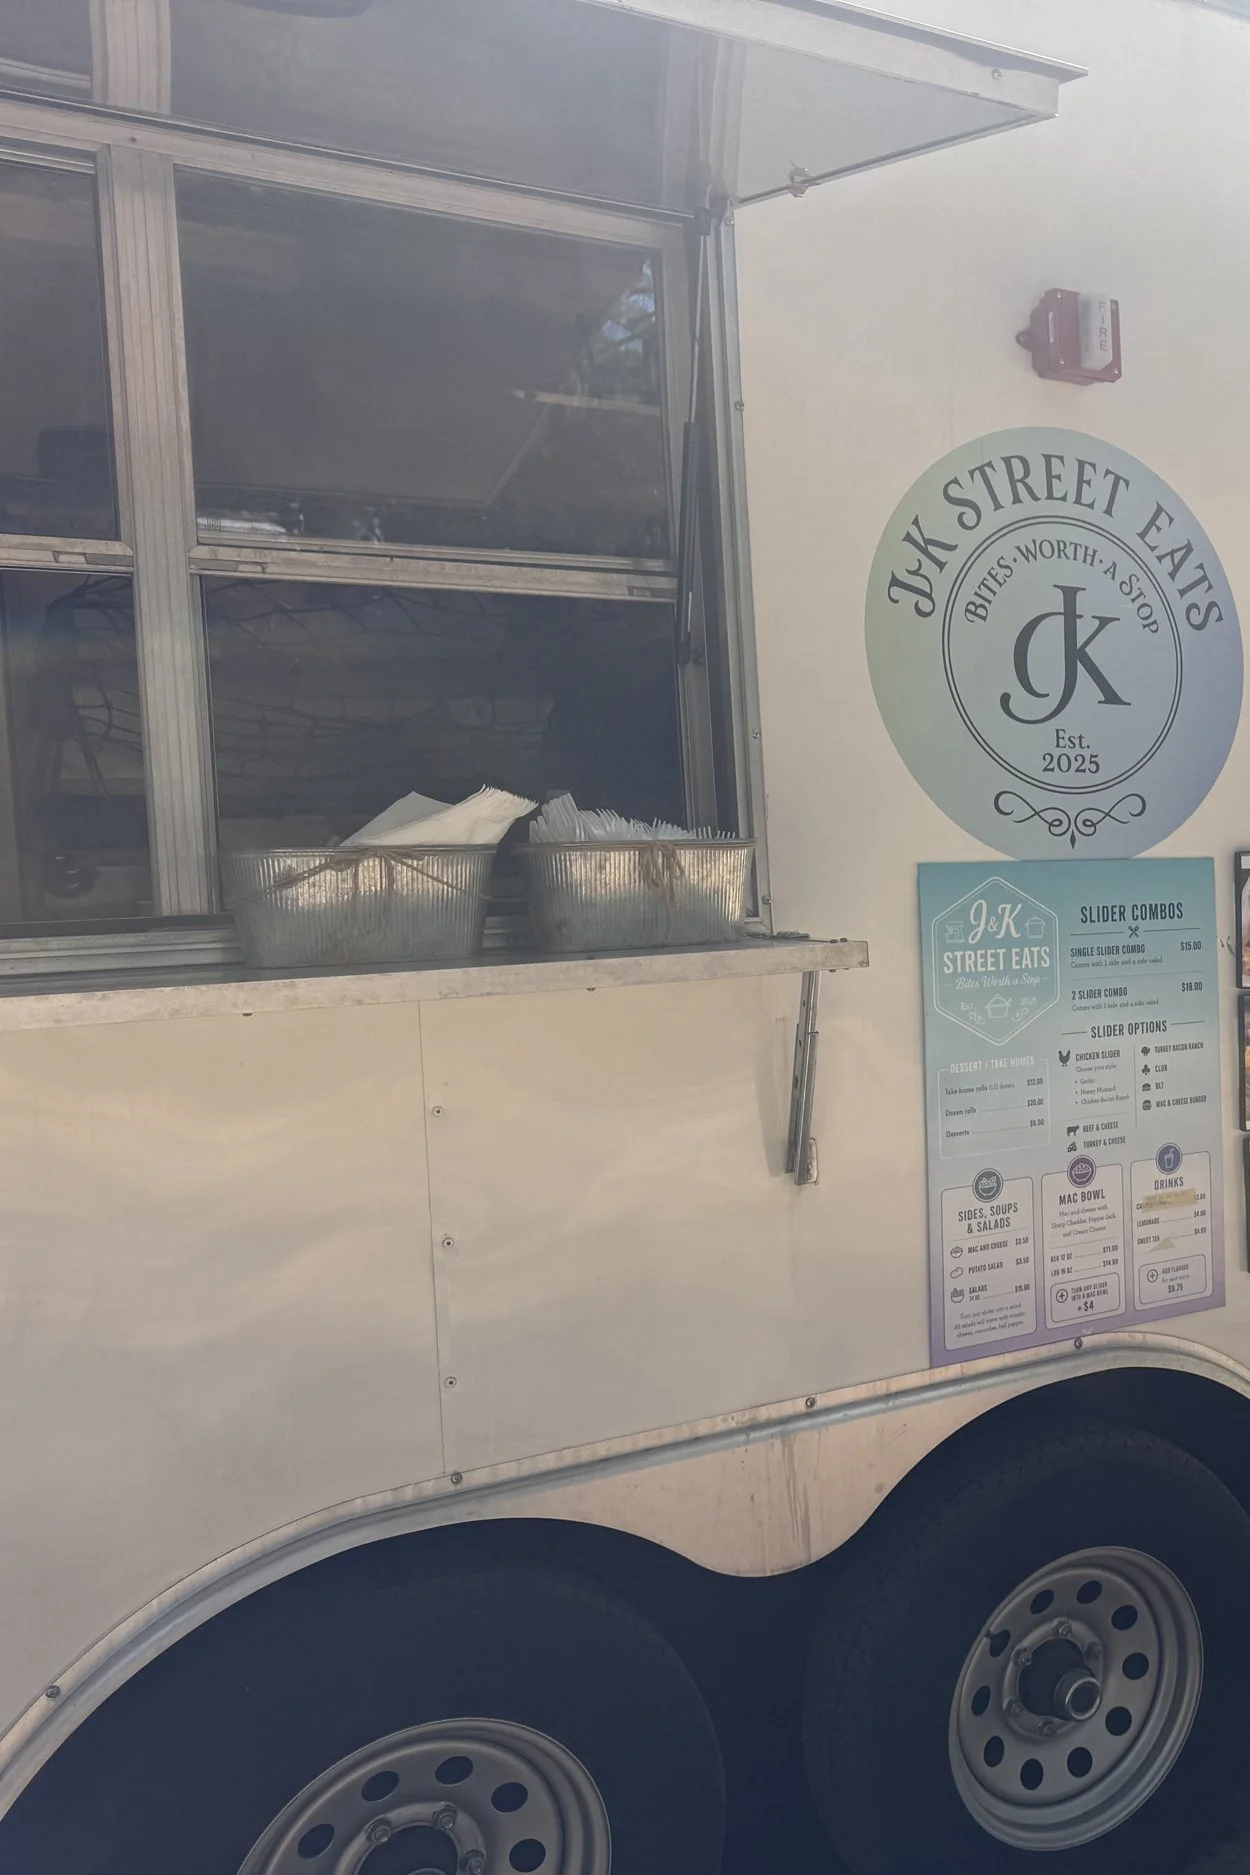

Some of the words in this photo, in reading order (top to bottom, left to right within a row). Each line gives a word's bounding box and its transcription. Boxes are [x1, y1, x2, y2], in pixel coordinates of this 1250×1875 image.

[1098, 300, 1108, 352] FIRE
[942, 452, 1131, 531] STREET
[1136, 500, 1223, 631] EATS
[1054, 728, 1090, 750] Est.
[1042, 753, 1100, 774] 2025
[968, 899, 1022, 944] J&K
[1080, 904, 1126, 924] SLIDER
[1131, 902, 1184, 921] COMBOS
[1070, 948, 1095, 958] SINGLE
[1096, 946, 1120, 956] SLIDER
[1122, 944, 1145, 954] COMBO
[1180, 941, 1202, 951] $15.00
[943, 948, 1005, 974] STREET
[1012, 946, 1050, 969] EATS
[1108, 958, 1119, 966] side
[1149, 954, 1162, 964] salad
[956, 976, 979, 990] Bites
[982, 976, 1010, 987] Worth
[1020, 973, 1040, 986] Stop
[1072, 991, 1076, 1000] 2
[1078, 989, 1102, 999] SLIDER
[1104, 987, 1128, 998] COMBO
[1182, 981, 1202, 992] $18.00
[1091, 1026, 1124, 1039] SLIDER
[1128, 1020, 1168, 1036] OPTIONS
[1075, 1052, 1100, 1062] CHICKEN
[1101, 1050, 1121, 1059] SLIDER
[1154, 1045, 1172, 1053] TURKEY
[950, 1061, 982, 1074] DESSERT
[991, 1058, 1008, 1070] TAKE
[1011, 1056, 1035, 1068] HOMES
[1155, 1064, 1168, 1072] CLUB
[1027, 1077, 1043, 1086] $12.00
[1155, 1081, 1164, 1089] BLT
[945, 1109, 963, 1117] Dozen
[964, 1106, 976, 1114] rolls
[1027, 1098, 1044, 1107] $20.00
[1156, 1100, 1166, 1108] MAC
[1172, 1097, 1188, 1106] CHEESE
[1189, 1095, 1207, 1104] BURGER
[945, 1130, 969, 1138] Desserts
[1082, 1124, 1094, 1132] BEEF
[1095, 1123, 1100, 1131] &
[1101, 1120, 1119, 1130] CHEESE
[1084, 1139, 1102, 1148] TURKEY
[1103, 1138, 1107, 1146] &
[1108, 1136, 1126, 1145] CHEESE
[1154, 1177, 1184, 1190] DRINKS
[1059, 1193, 1077, 1206] MAC
[1081, 1188, 1106, 1203] BOWL
[958, 1208, 987, 1222] SIDES,
[990, 1202, 1018, 1216] SOUPS
[967, 1223, 973, 1234] &
[977, 1217, 1011, 1232] SALADS
[1137, 1217, 1160, 1227] LEMONADE
[968, 1245, 978, 1254] MAC
[980, 1243, 990, 1252] AND
[991, 1240, 1008, 1250] CHEESE
[1015, 1236, 1029, 1246] $3.50
[1137, 1236, 1151, 1245] SWEET
[968, 1264, 986, 1274] POTATO
[988, 1262, 1003, 1271] SALAD
[969, 1284, 988, 1294] SALADS
[1084, 1300, 1094, 1312] $4
